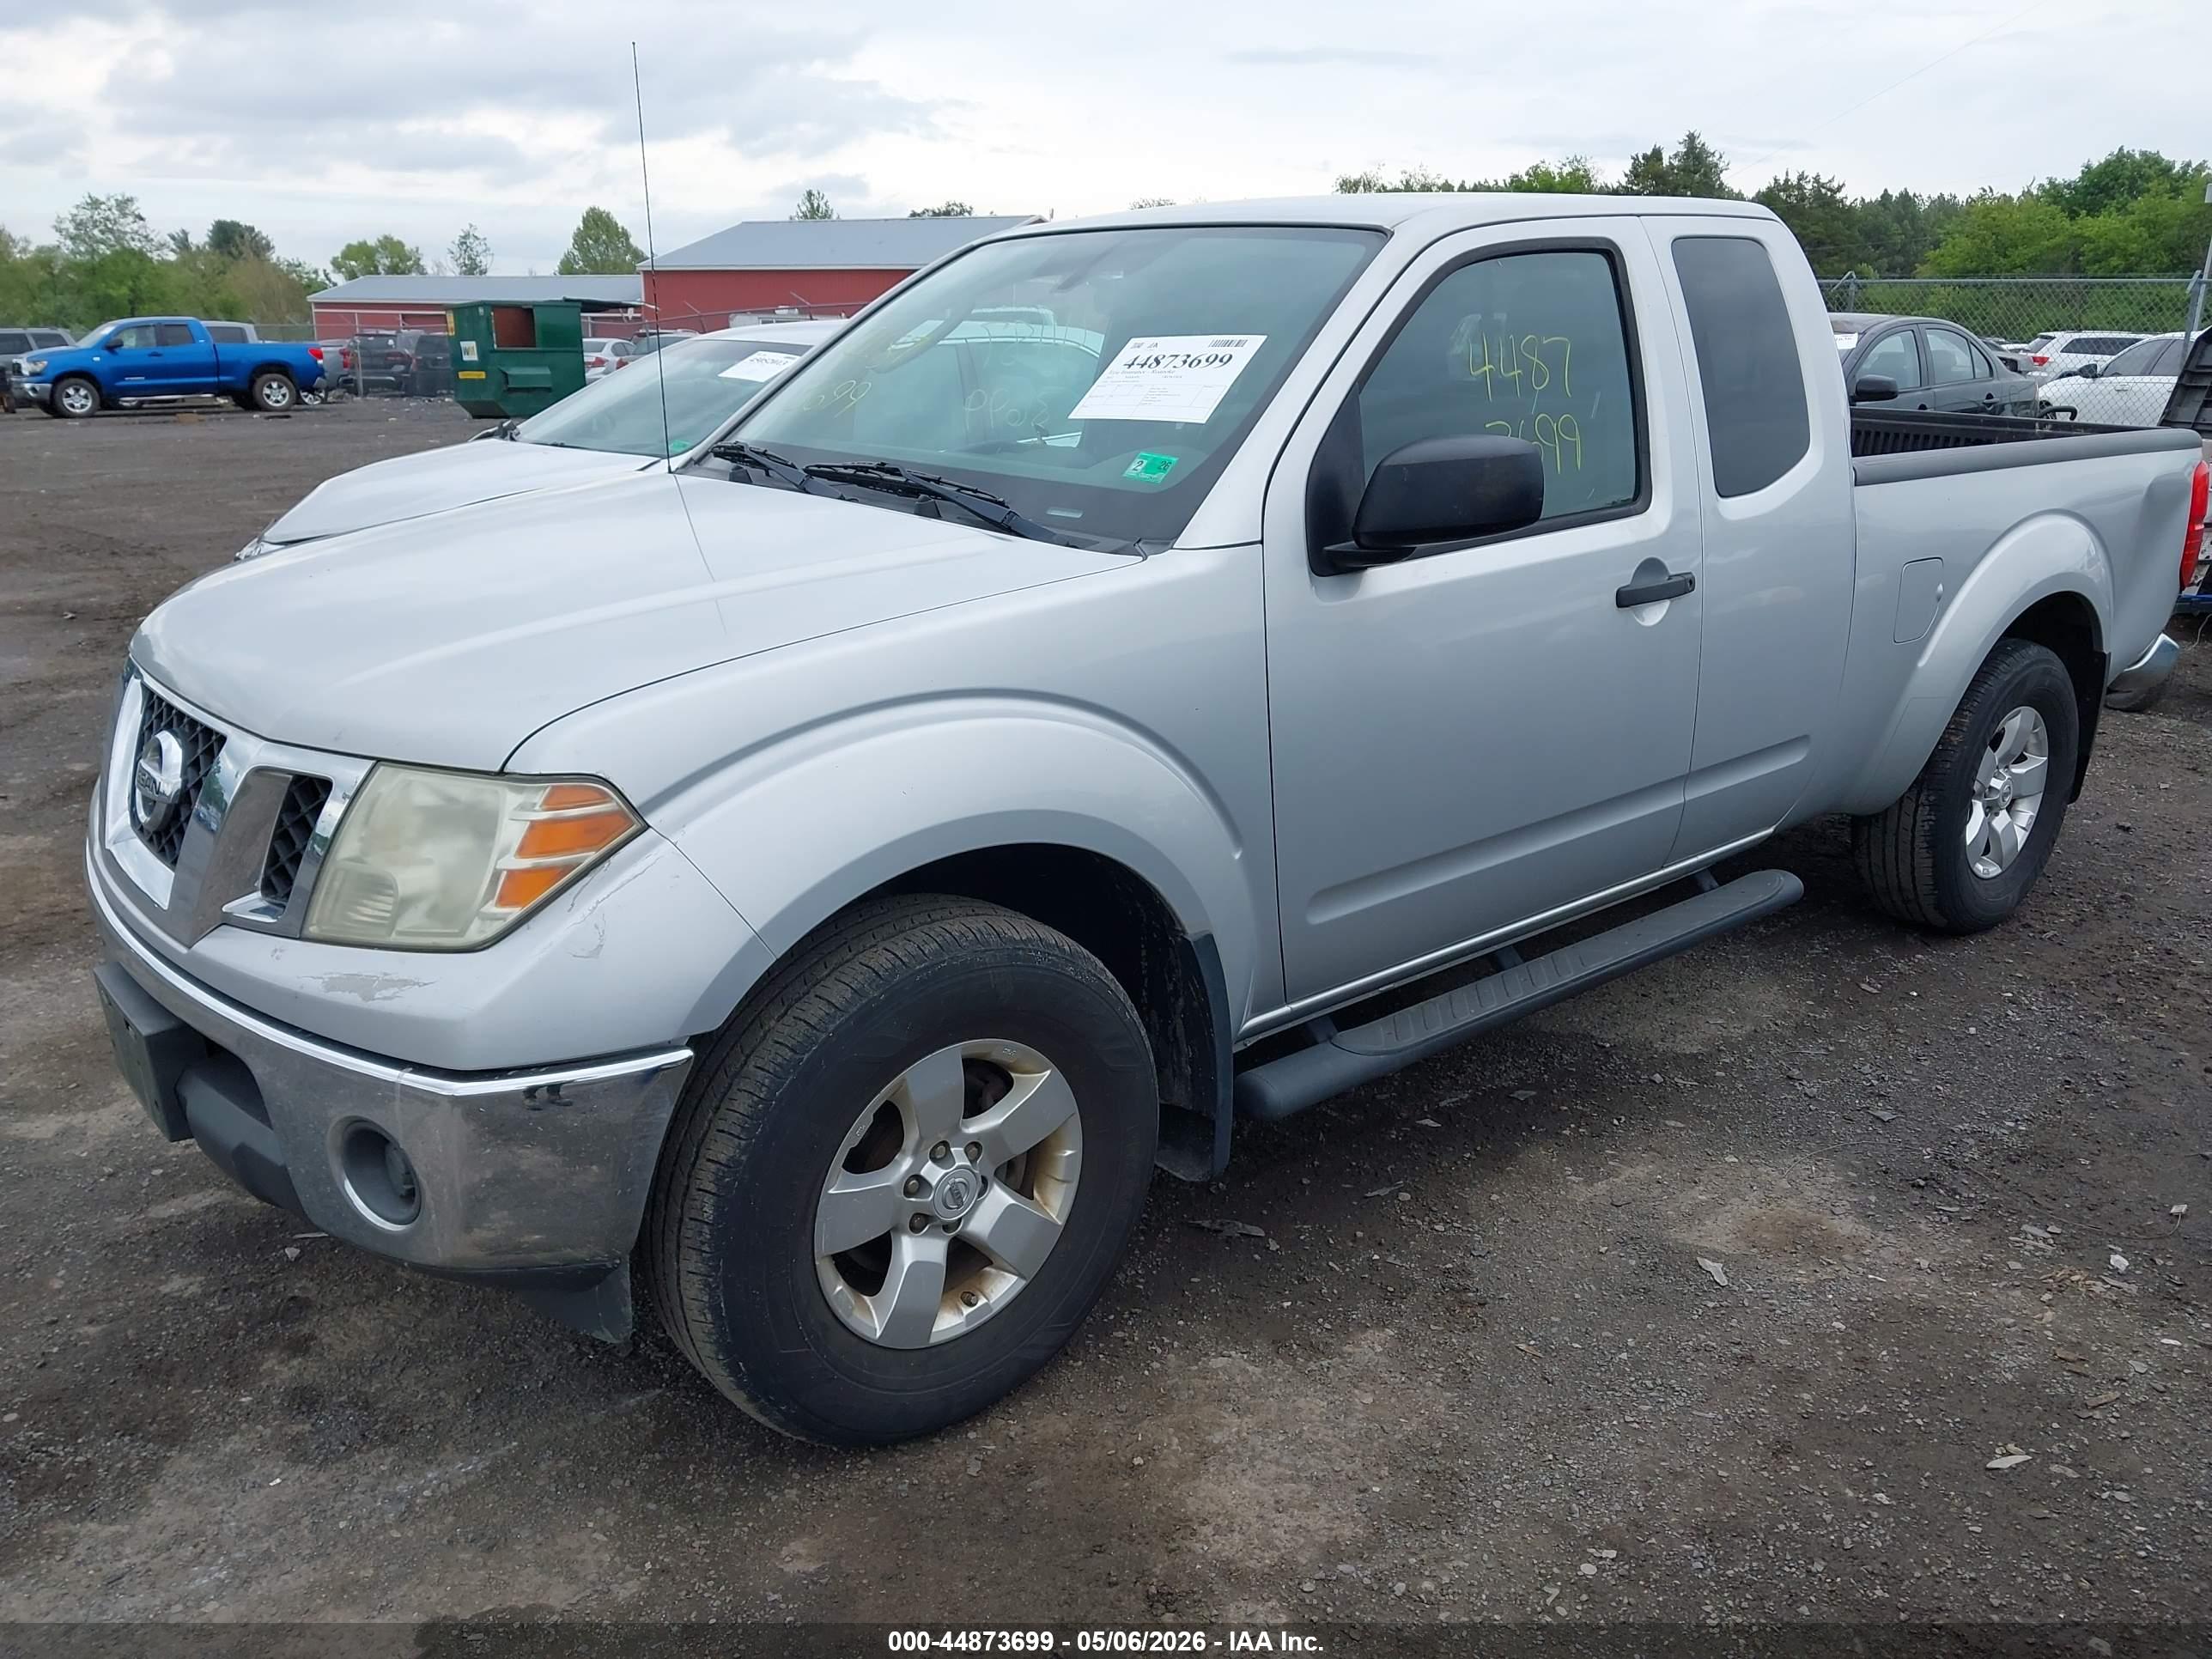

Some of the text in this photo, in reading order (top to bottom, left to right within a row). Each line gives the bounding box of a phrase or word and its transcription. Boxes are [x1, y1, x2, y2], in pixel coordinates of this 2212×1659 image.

[1123, 352, 1234, 369] 44873699
[1468, 331, 1572, 402] 4487
[1132, 460, 1172, 471] 2 26
